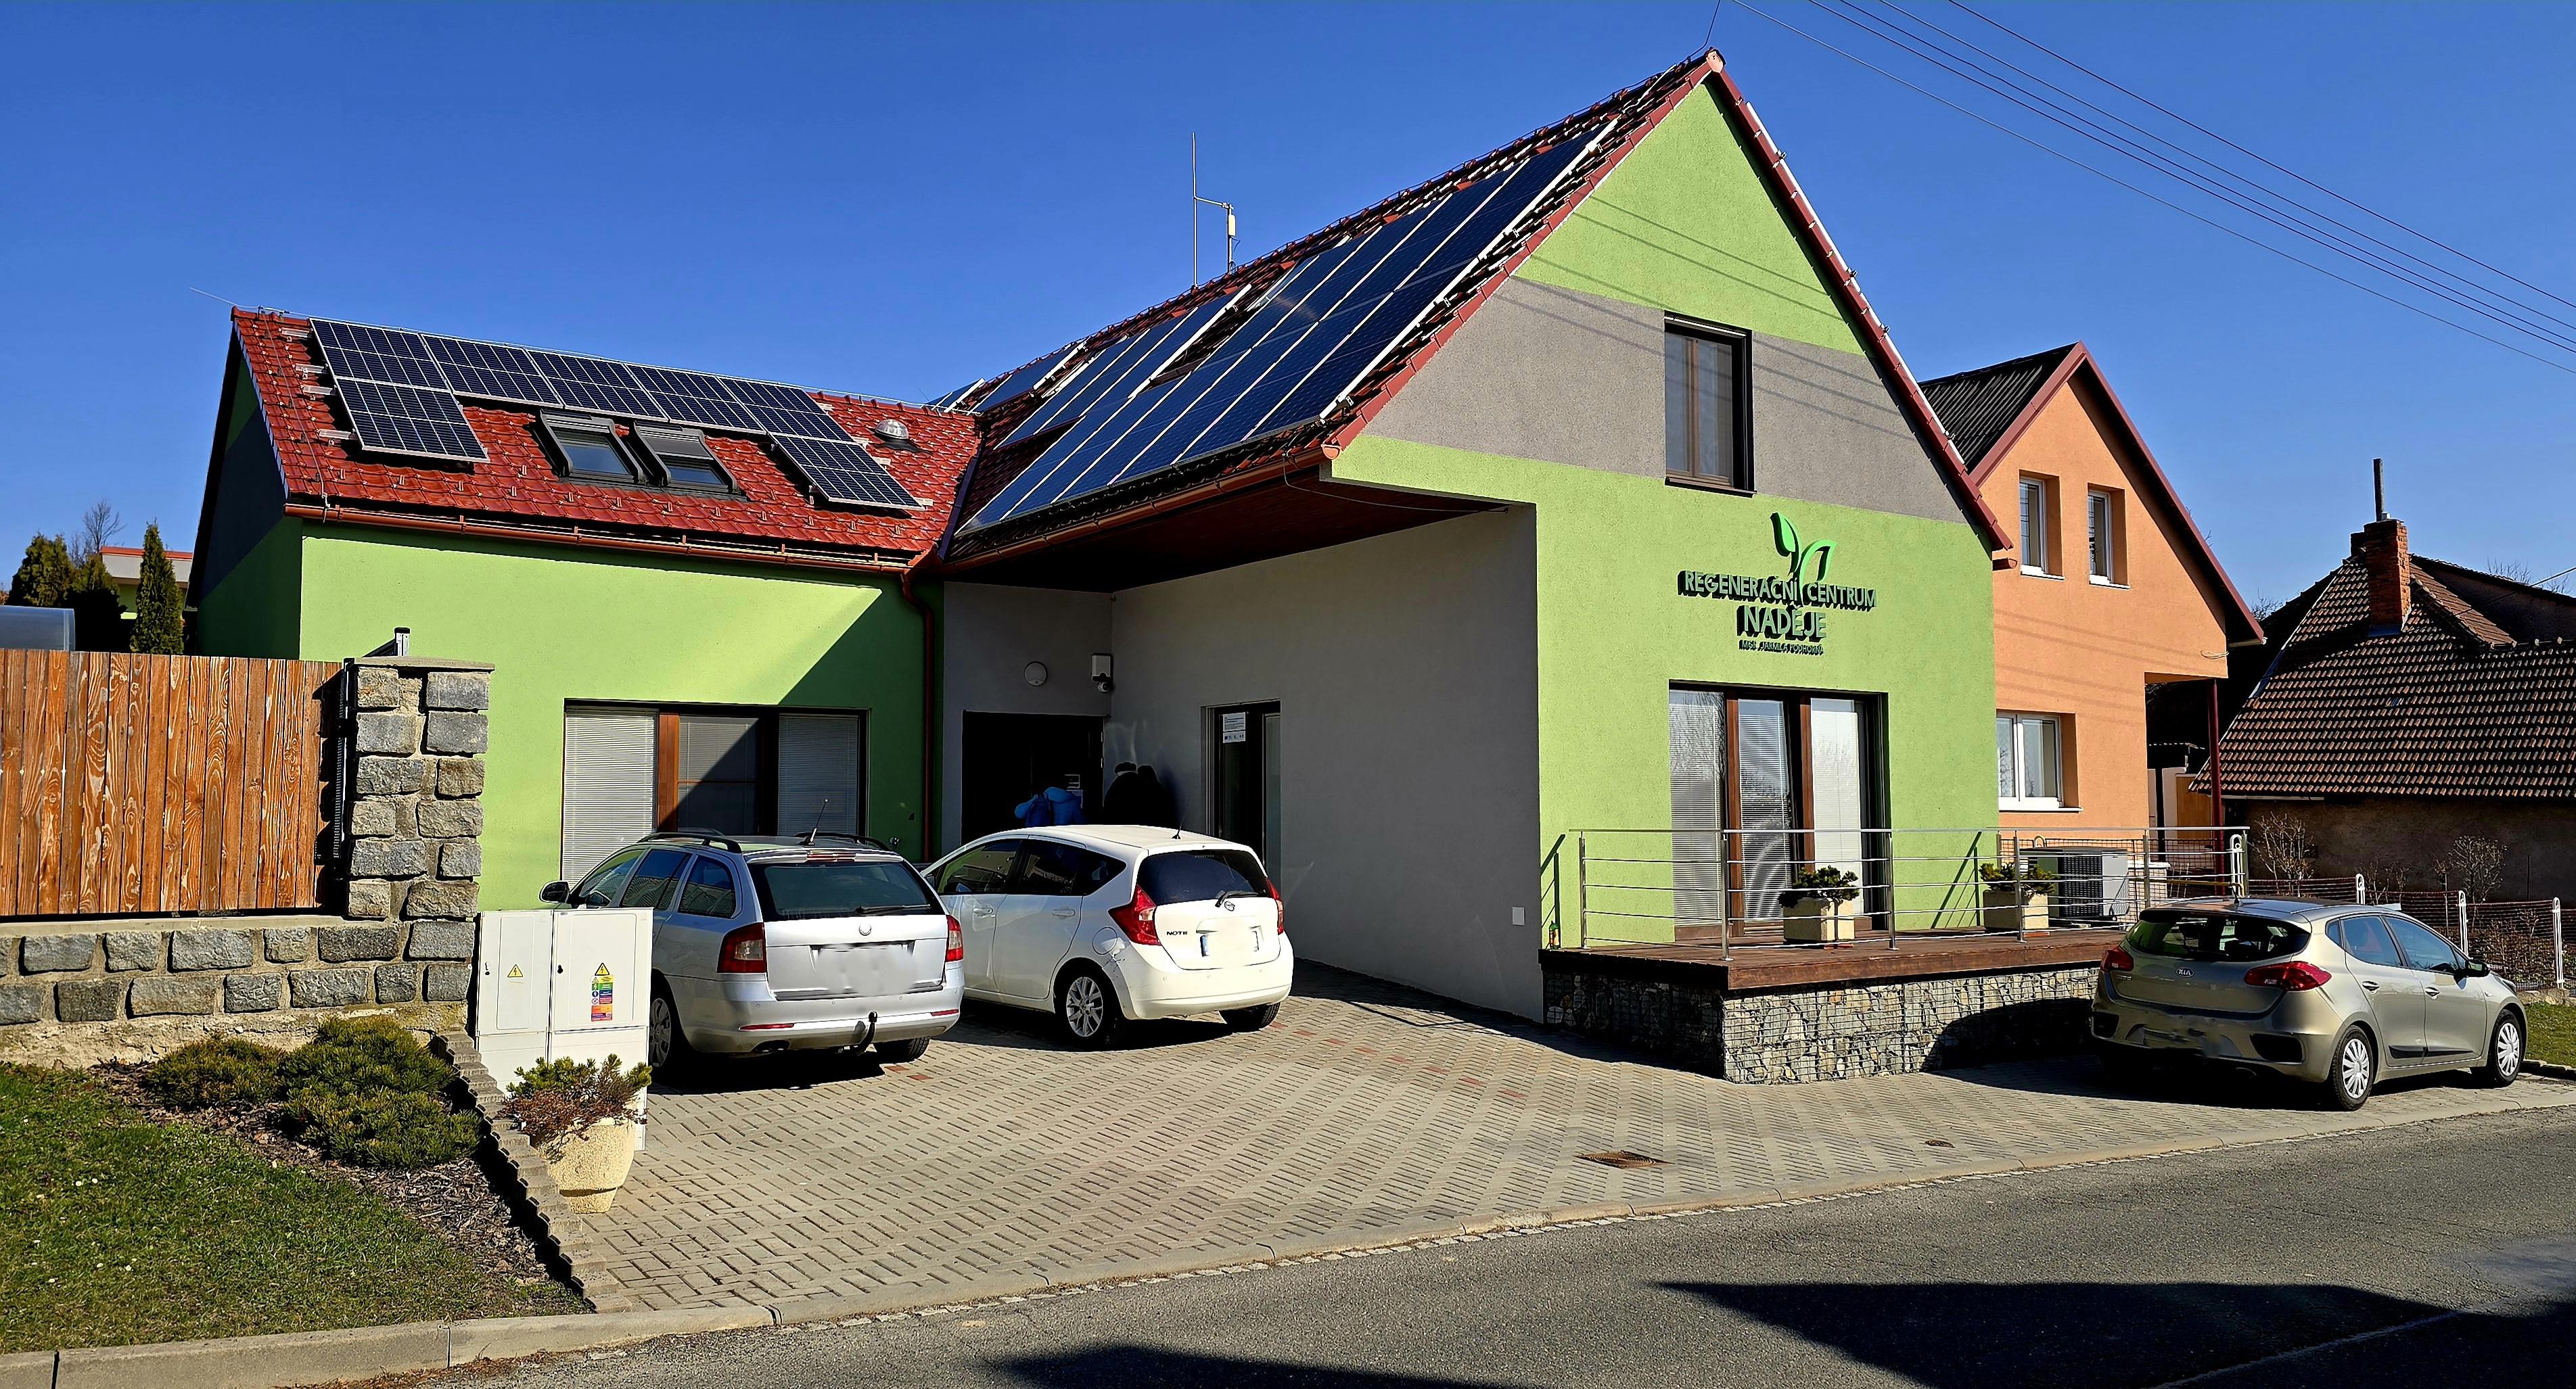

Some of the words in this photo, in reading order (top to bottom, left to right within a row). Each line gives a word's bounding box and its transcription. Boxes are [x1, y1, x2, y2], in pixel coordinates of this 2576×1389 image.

[1680, 570, 1799, 603] REGENERAČNÍ
[1804, 581, 1877, 609] CENTRUM
[1740, 605, 1826, 639] NADĚJE
[2177, 968, 2192, 976] KIA
